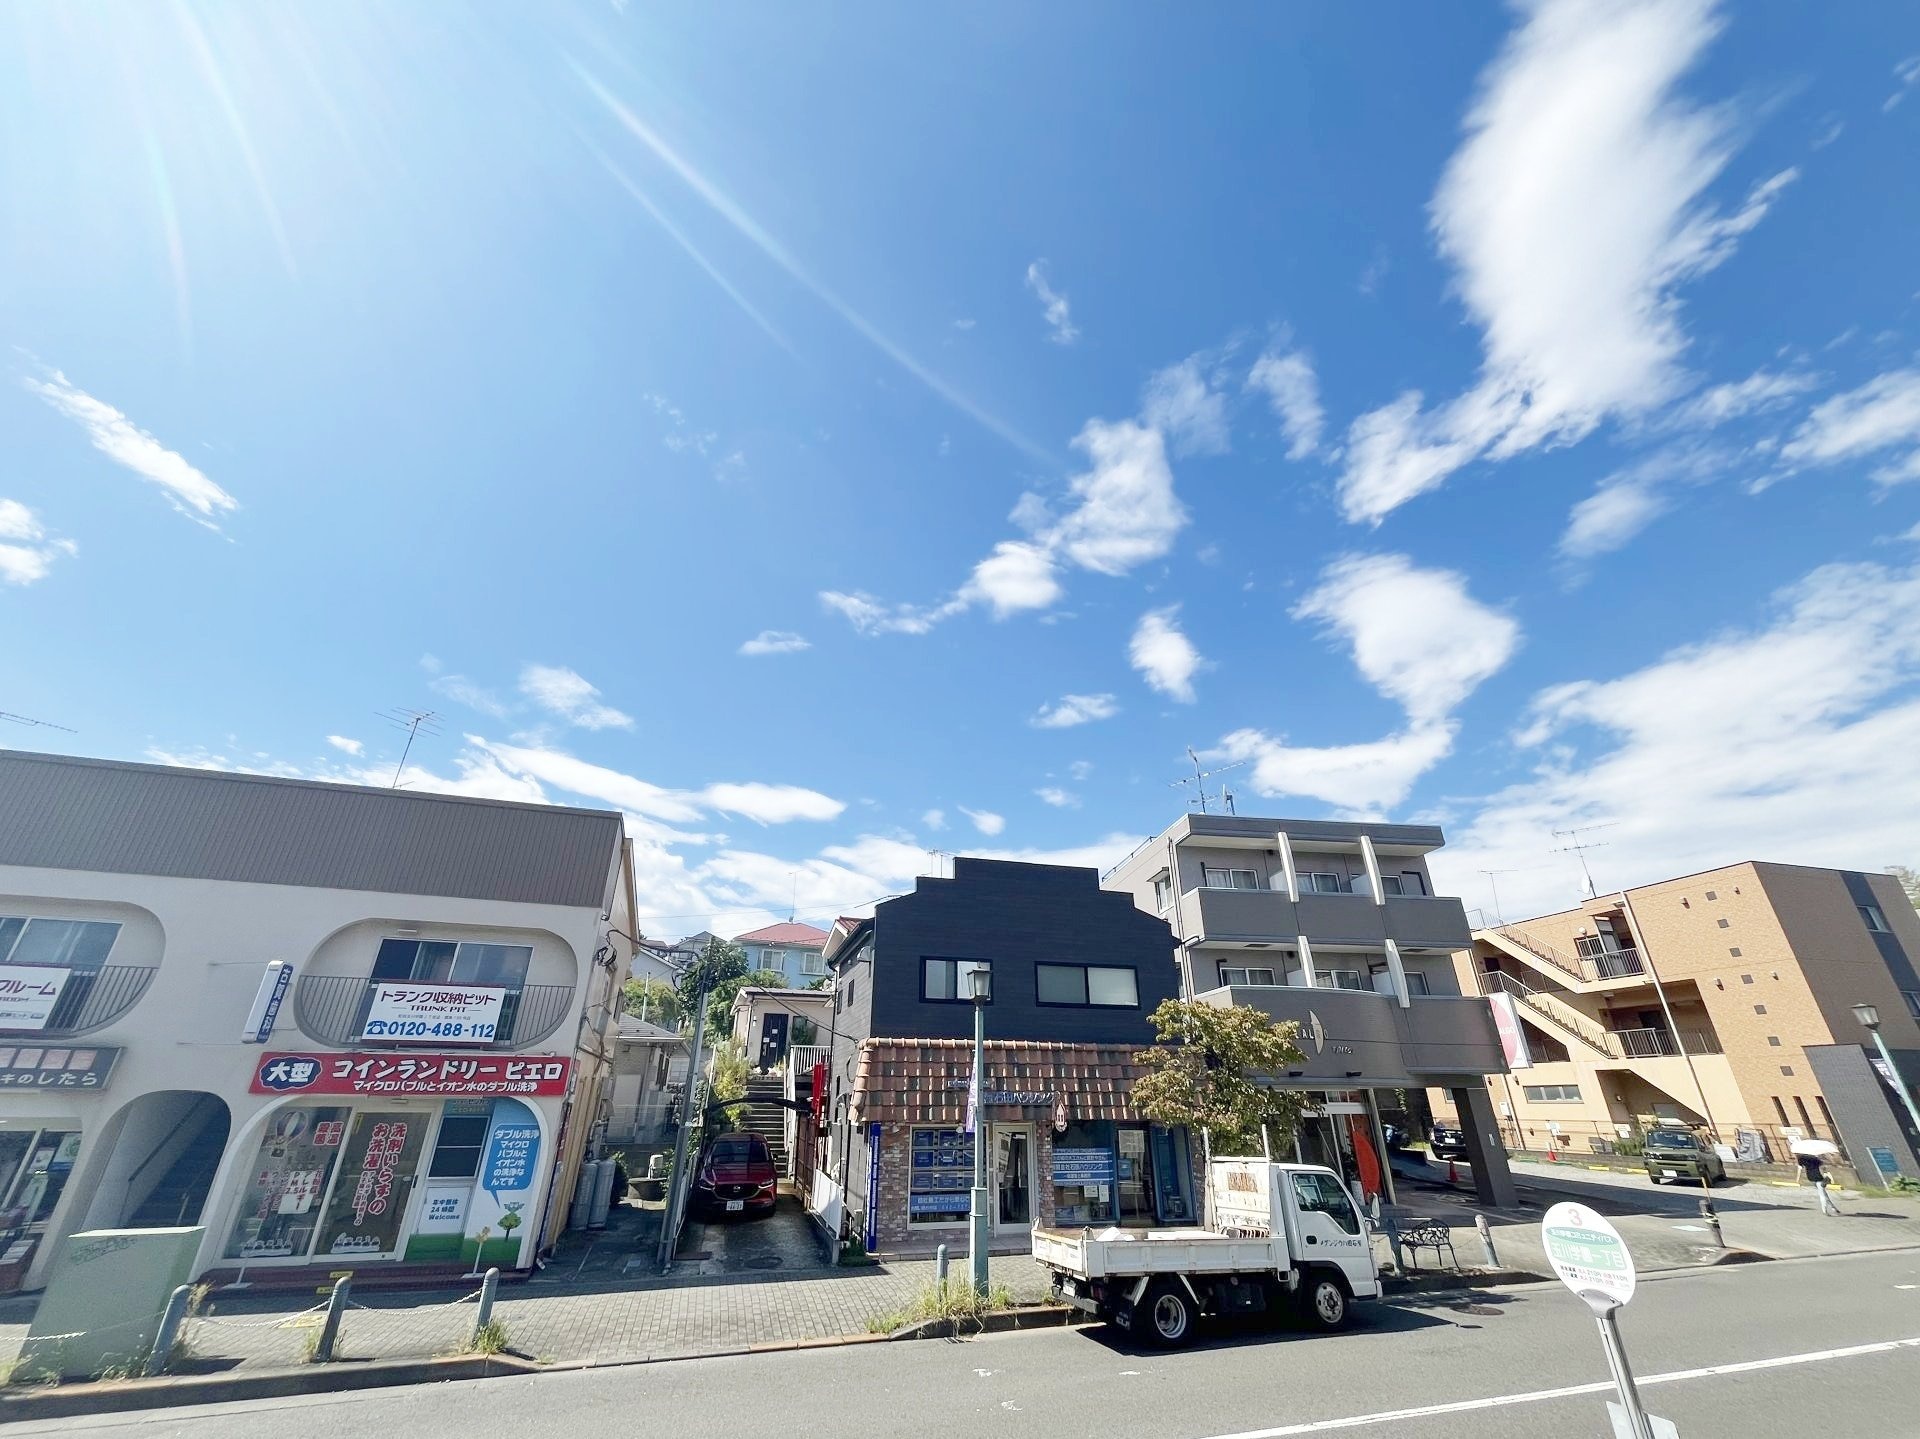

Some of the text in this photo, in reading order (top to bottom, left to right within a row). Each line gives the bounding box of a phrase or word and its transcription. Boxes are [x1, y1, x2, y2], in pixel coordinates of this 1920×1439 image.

[381, 991, 497, 1005] トランク収納ピット
[388, 1021, 495, 1037] 0120-488-112
[268, 1062, 314, 1083] 大型
[332, 1060, 564, 1081] コインランドリー ピエロ
[353, 1080, 538, 1092] マイクロバブルとイオン水のダブル洗浄
[495, 1129, 540, 1139] ダブル洗浄
[496, 1159, 526, 1167] イオン水
[1567, 1208, 1583, 1227] 3
